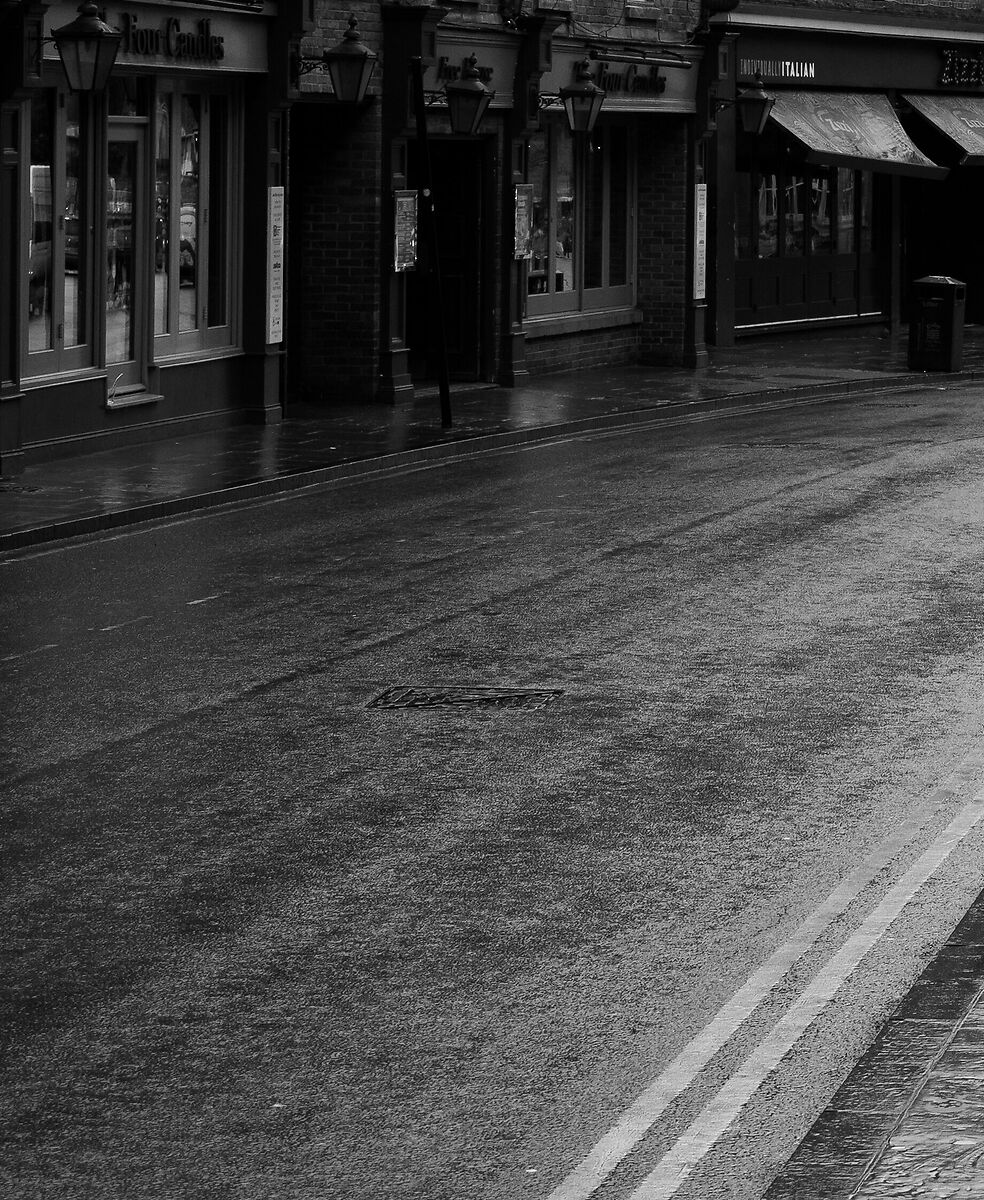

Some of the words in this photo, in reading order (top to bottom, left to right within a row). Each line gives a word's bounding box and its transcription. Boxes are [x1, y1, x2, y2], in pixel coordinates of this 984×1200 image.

[123, 12, 162, 55] Four
[166, 17, 225, 60] Candles
[624, 64, 667, 93] Candles
[781, 61, 815, 78] ITALIAN
[942, 48, 984, 85] Zizzi
